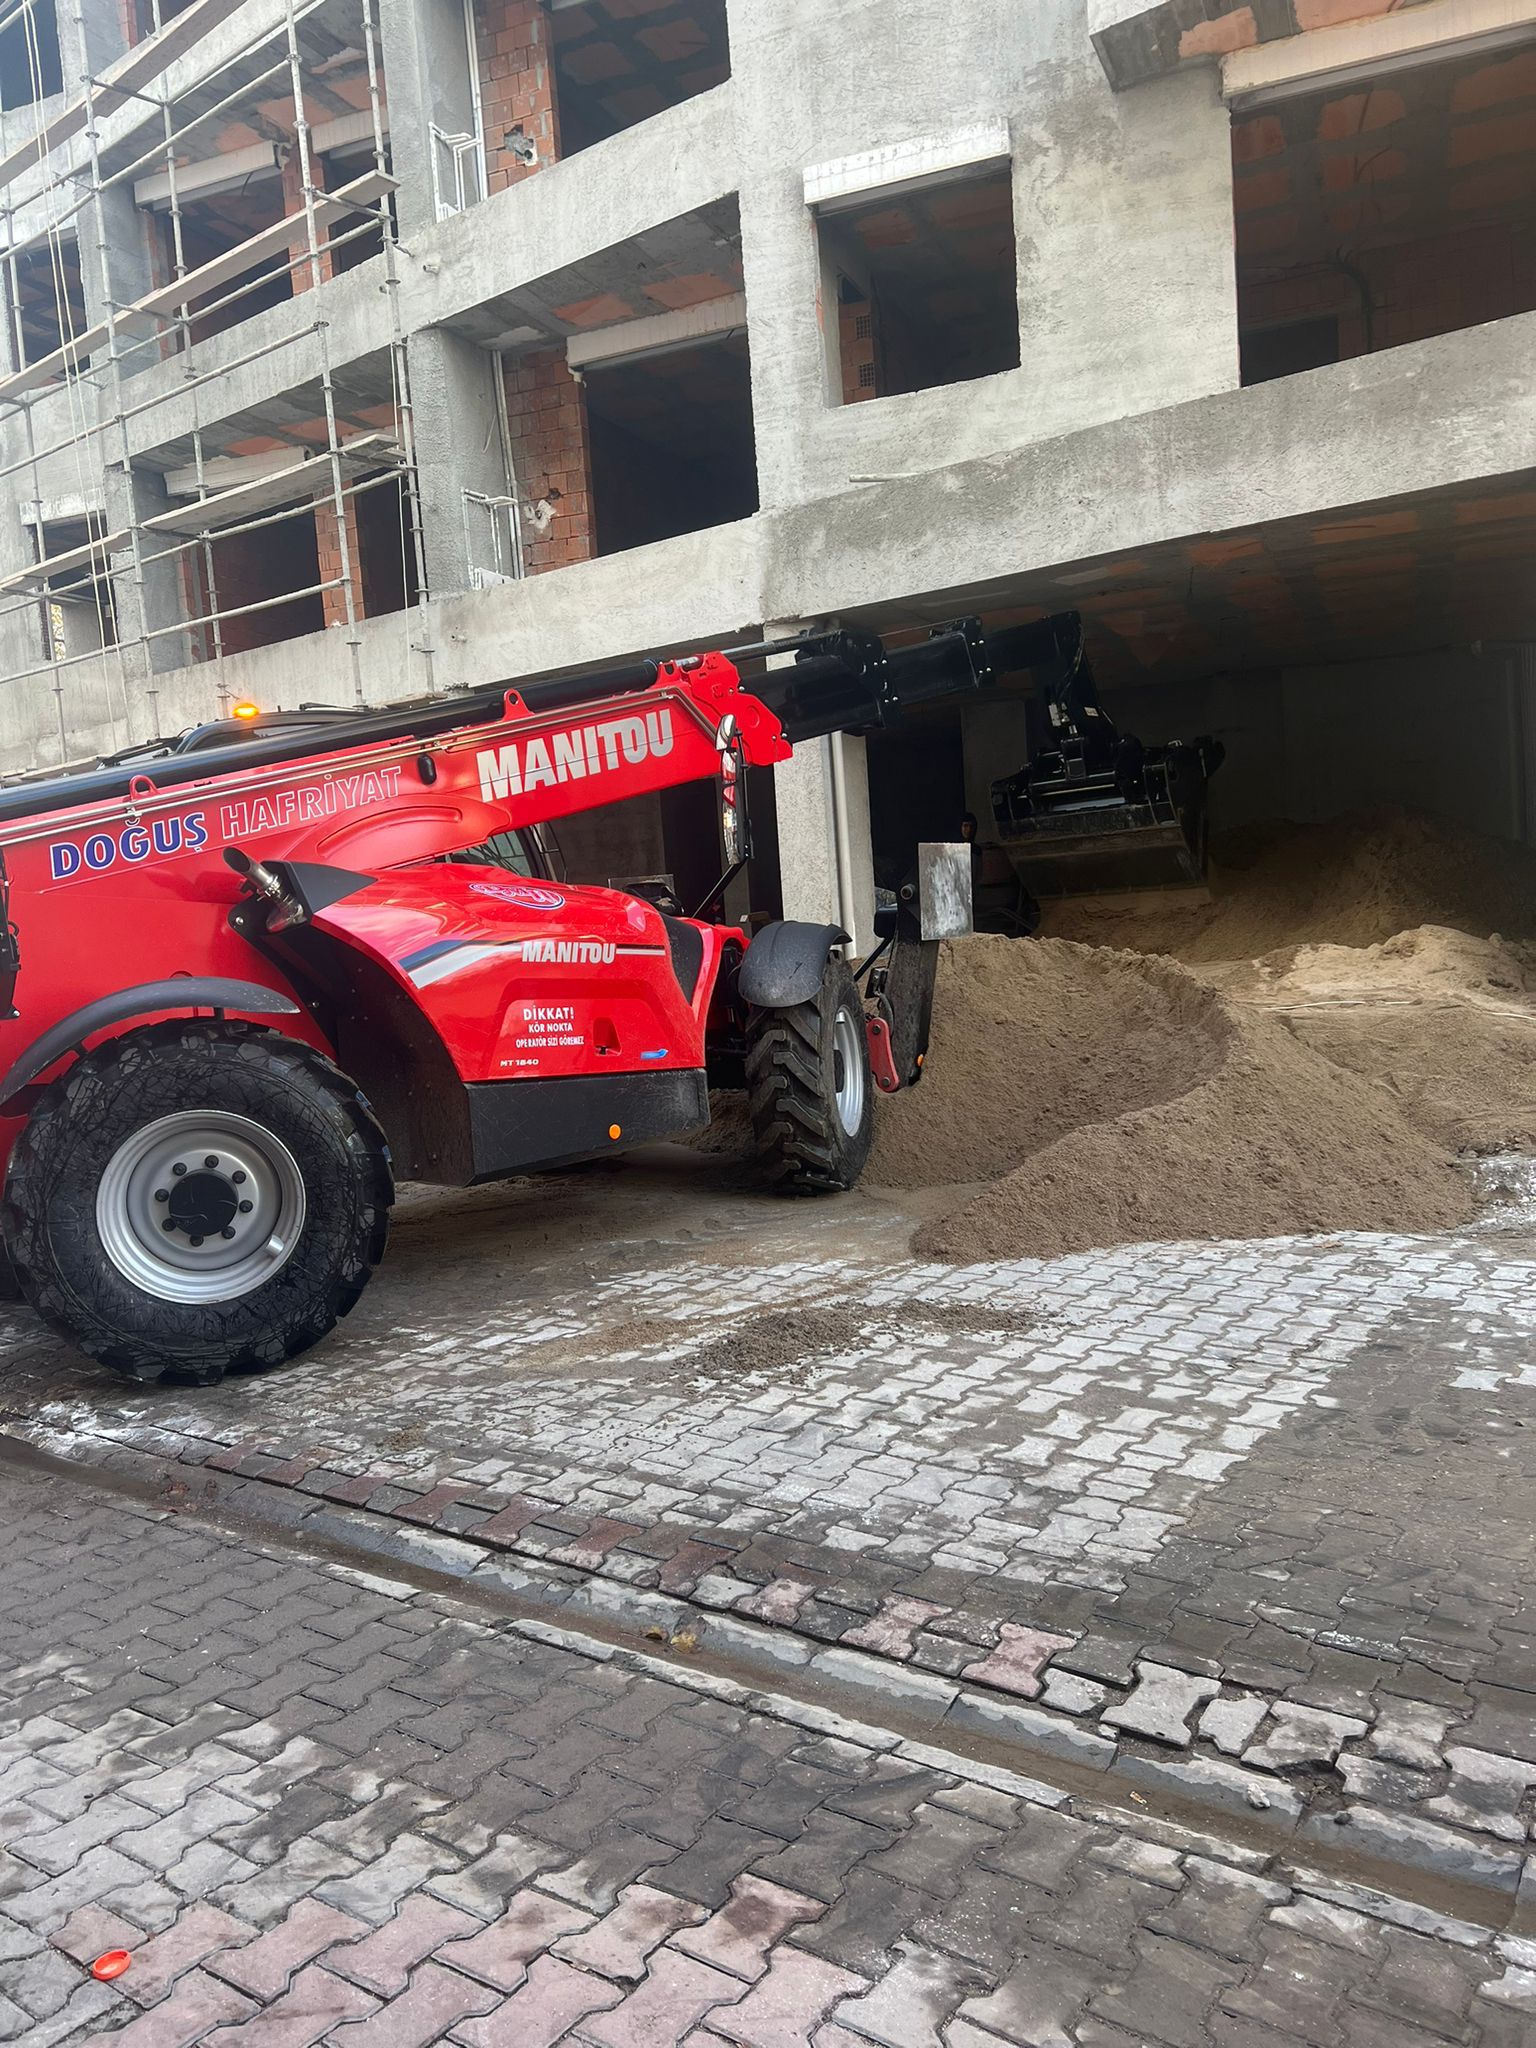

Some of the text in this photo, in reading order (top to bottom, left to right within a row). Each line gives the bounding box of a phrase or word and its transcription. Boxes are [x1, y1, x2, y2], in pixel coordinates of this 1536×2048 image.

[476, 708, 673, 803] MANITOU
[49, 766, 402, 880] DOĞUŞ HAFRİYAT
[522, 940, 616, 964] MANITOU
[523, 1005, 574, 1021] DİKKAT!
[528, 1021, 573, 1033] KÖR NOKTA
[500, 1058, 539, 1067] MT 1840
